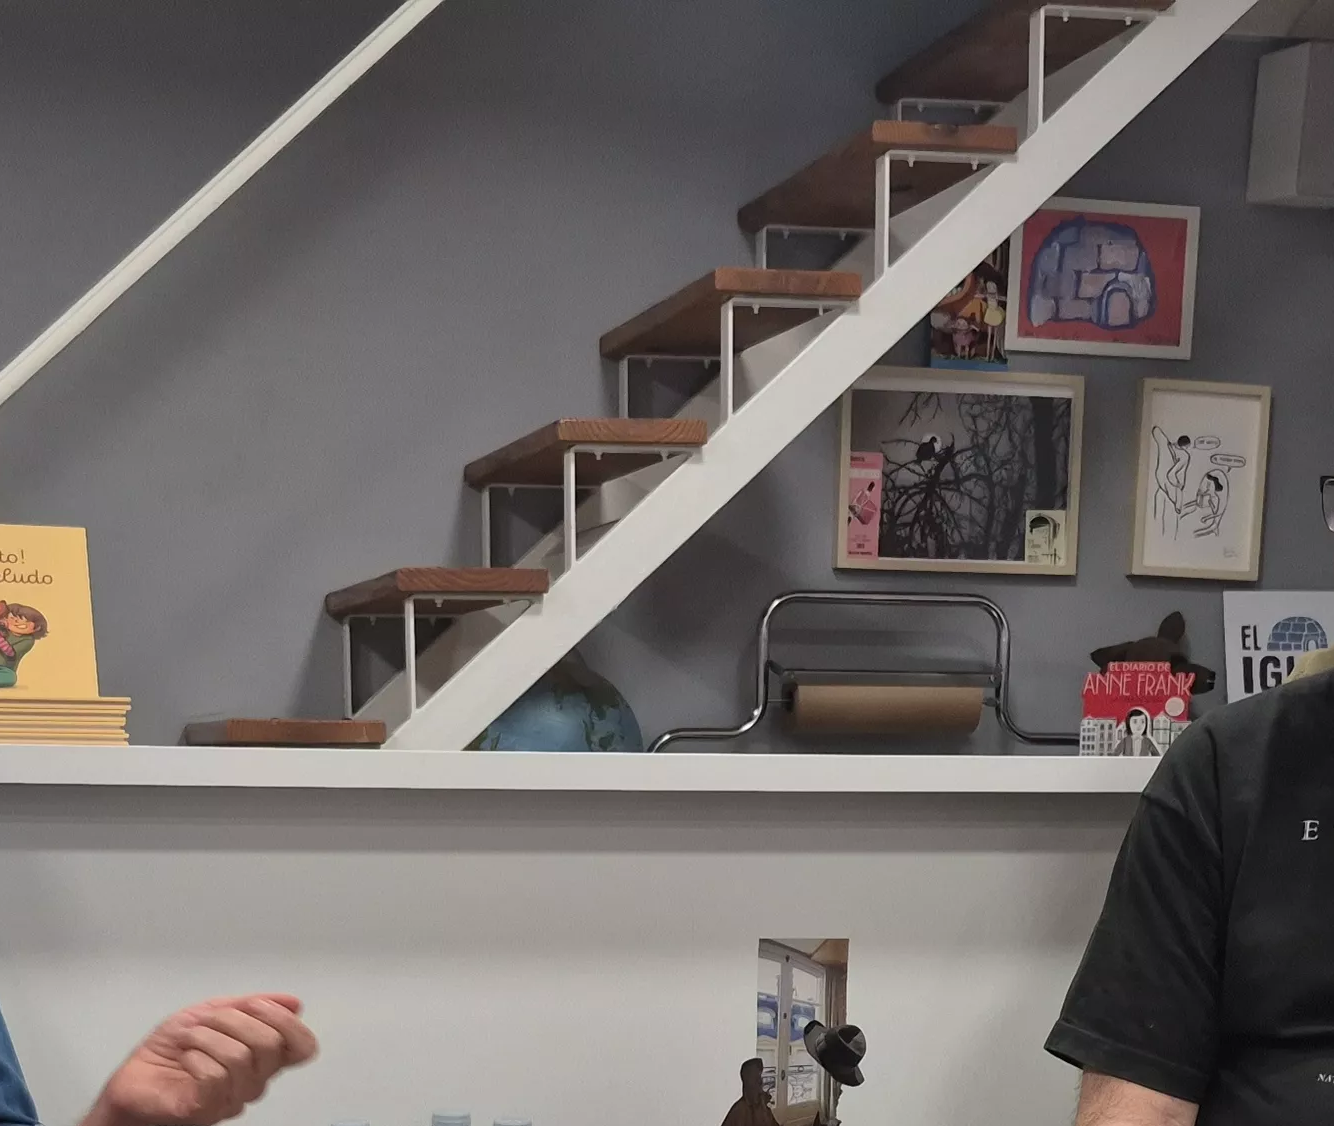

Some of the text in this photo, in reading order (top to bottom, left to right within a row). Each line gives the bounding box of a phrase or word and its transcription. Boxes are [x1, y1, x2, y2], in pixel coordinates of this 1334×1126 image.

[1241, 625, 1261, 650] EL
[1110, 662, 1171, 672] EL DIARIO DE
[1083, 672, 1196, 696] ANNE FRANK
